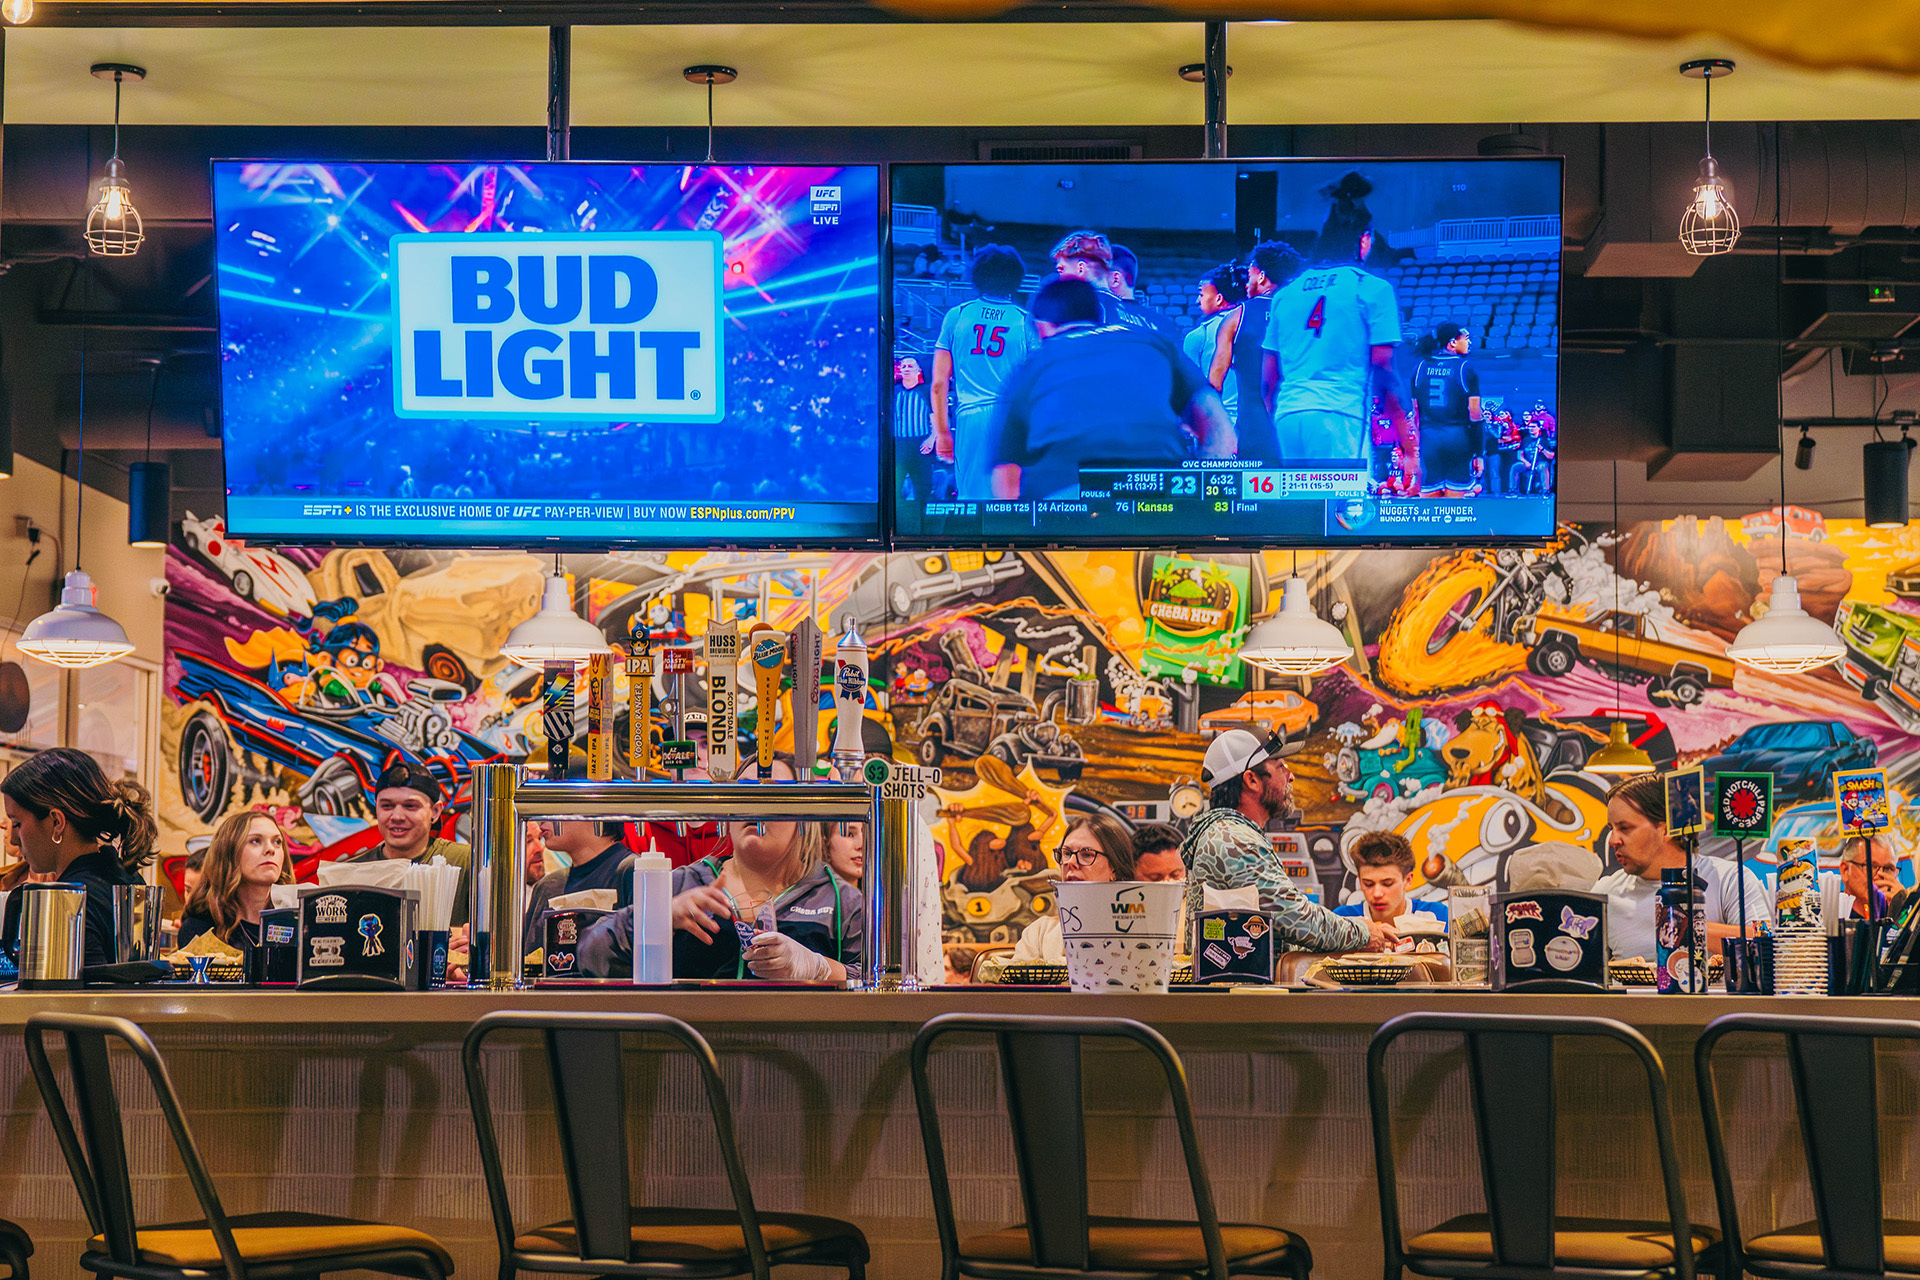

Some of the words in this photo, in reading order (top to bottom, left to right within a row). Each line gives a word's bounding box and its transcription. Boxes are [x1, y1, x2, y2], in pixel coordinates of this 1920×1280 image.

[815, 189, 836, 197] UFC
[813, 203, 838, 211] ESPN
[813, 216, 839, 225] LIVE
[451, 255, 658, 325] BUD
[980, 307, 1006, 321] TERRY
[1306, 295, 1326, 339] 4
[970, 324, 1010, 357] 15
[413, 329, 701, 400] LIGHT
[1429, 378, 1445, 408] 3
[1182, 460, 1200, 468] OVC
[1201, 460, 1263, 468] CHAMPIONSHIP
[1127, 474, 1132, 482] 2
[1134, 473, 1158, 482] SIUE
[1210, 474, 1234, 485] 6:32
[1295, 473, 1307, 481] SE
[1310, 473, 1359, 481] MISSOURI
[1113, 482, 1134, 491] 21-11
[1135, 482, 1158, 491] (13-7)
[1171, 476, 1197, 495] 23
[1206, 486, 1219, 496] 30
[1223, 486, 1237, 496] 1st
[1249, 476, 1274, 493] 16
[1288, 482, 1309, 490] 21-11
[1310, 482, 1334, 490] (15-5)
[355, 505, 367, 517] IS
[370, 505, 392, 517] THE
[394, 505, 456, 517] EXCLUSIVE
[459, 505, 493, 518] HOME
[495, 506, 510, 518] OF
[512, 506, 542, 518] UFC
[544, 506, 624, 519] PAY-PER-VIEW
[633, 507, 656, 519] BUY
[660, 507, 687, 519] NOW
[690, 506, 796, 522] ESPNplus.com/PPV
[985, 503, 1012, 512] MCBB
[1013, 503, 1030, 512] T25
[1037, 503, 1047, 512] 24
[1049, 502, 1088, 512] Arizona
[1116, 502, 1129, 512] 76
[1137, 502, 1174, 512] Kansas
[1214, 502, 1229, 512] 83
[1236, 502, 1258, 512] Final
[1380, 506, 1419, 515] NUGGETS
[1434, 506, 1473, 515] THUNDER
[1190, 607, 1222, 626] HUT
[709, 634, 737, 647] HUSS
[625, 658, 651, 673] IPA
[711, 676, 727, 755] BLONDE
[634, 721, 643, 760] VOODOO
[868, 764, 884, 780] $3
[892, 767, 941, 784] JELL-O
[883, 782, 925, 799] SHOTS
[1725, 780, 1742, 798] HOT
[1741, 780, 1764, 800] CHILI
[1847, 778, 1875, 791] SMASH
[1722, 797, 1735, 821] RED
[316, 906, 346, 917] WORK
[975, 901, 983, 912] 1
[1111, 903, 1146, 914] WM
